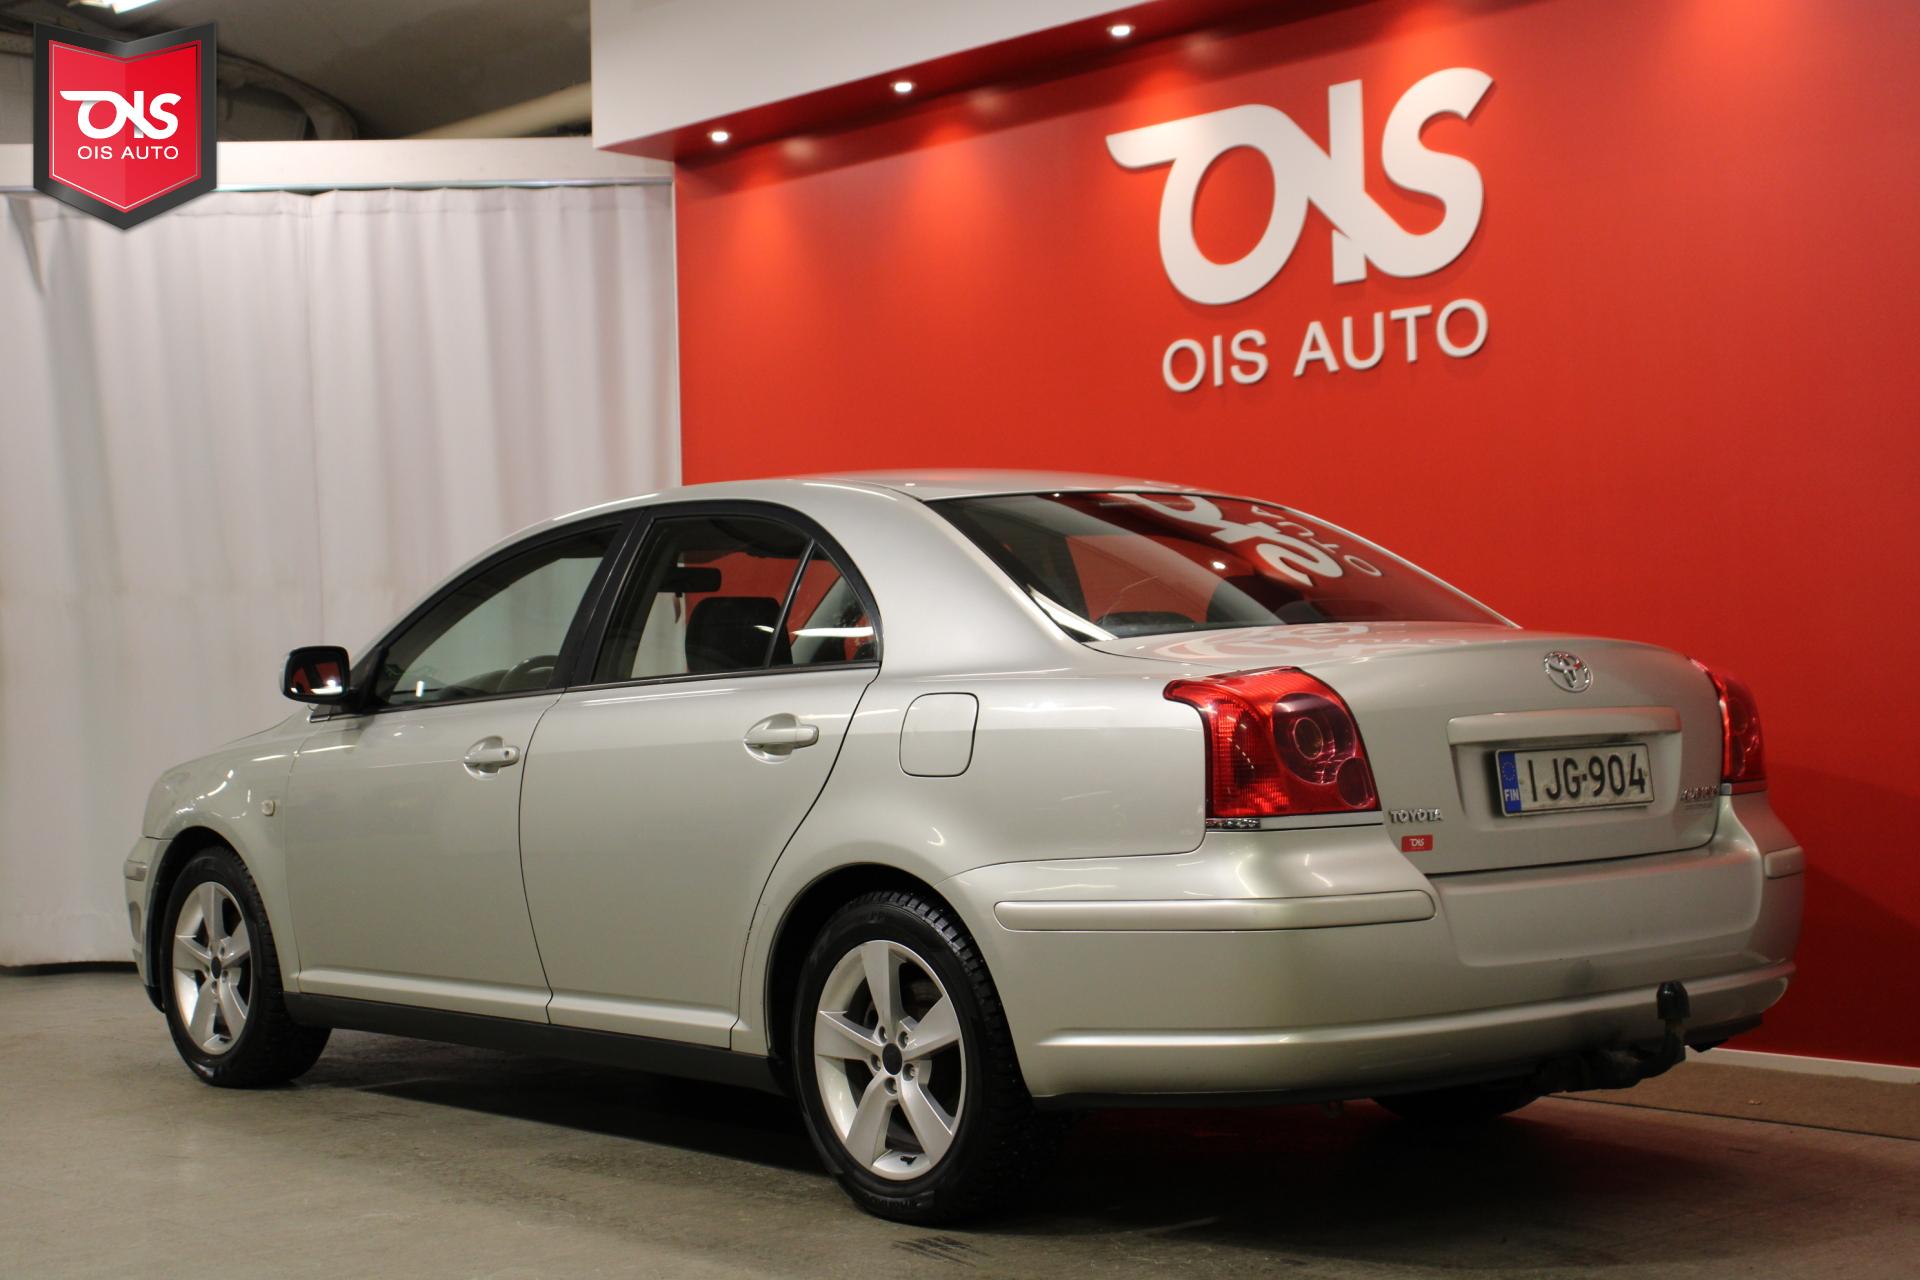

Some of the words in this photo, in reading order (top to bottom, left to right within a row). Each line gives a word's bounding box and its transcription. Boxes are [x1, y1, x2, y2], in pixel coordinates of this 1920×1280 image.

[1105, 67, 1494, 305] OIS
[1162, 329, 1268, 392] OIS
[1293, 298, 1488, 377] AUTO
[1389, 808, 1443, 823] TOYOTA
[1504, 788, 1519, 802] FIN
